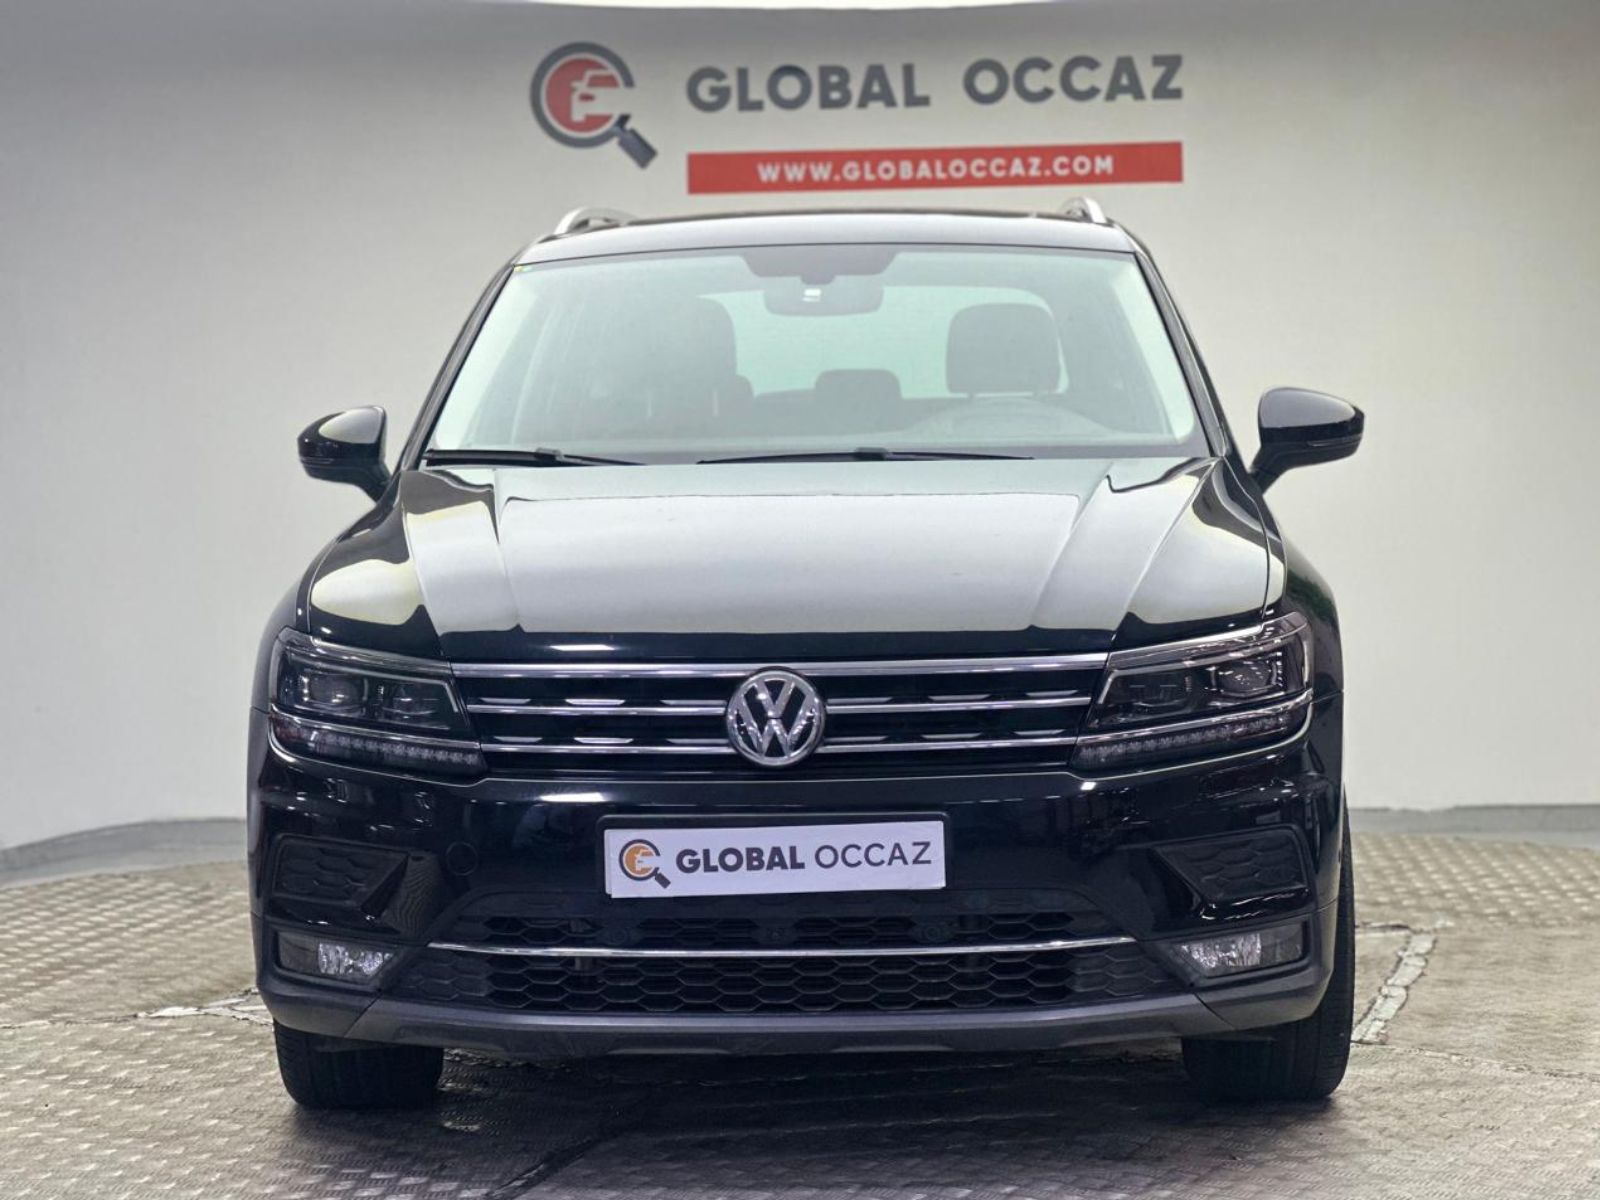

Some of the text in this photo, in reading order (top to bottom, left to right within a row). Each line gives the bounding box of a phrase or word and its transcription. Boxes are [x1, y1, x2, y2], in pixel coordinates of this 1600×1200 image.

[686, 54, 1184, 113] GLOBAL OCCAZ
[757, 154, 1114, 185] WWW.GLOBALOCCAZ.COM
[675, 841, 932, 874] GLOBAL OCCAZ
